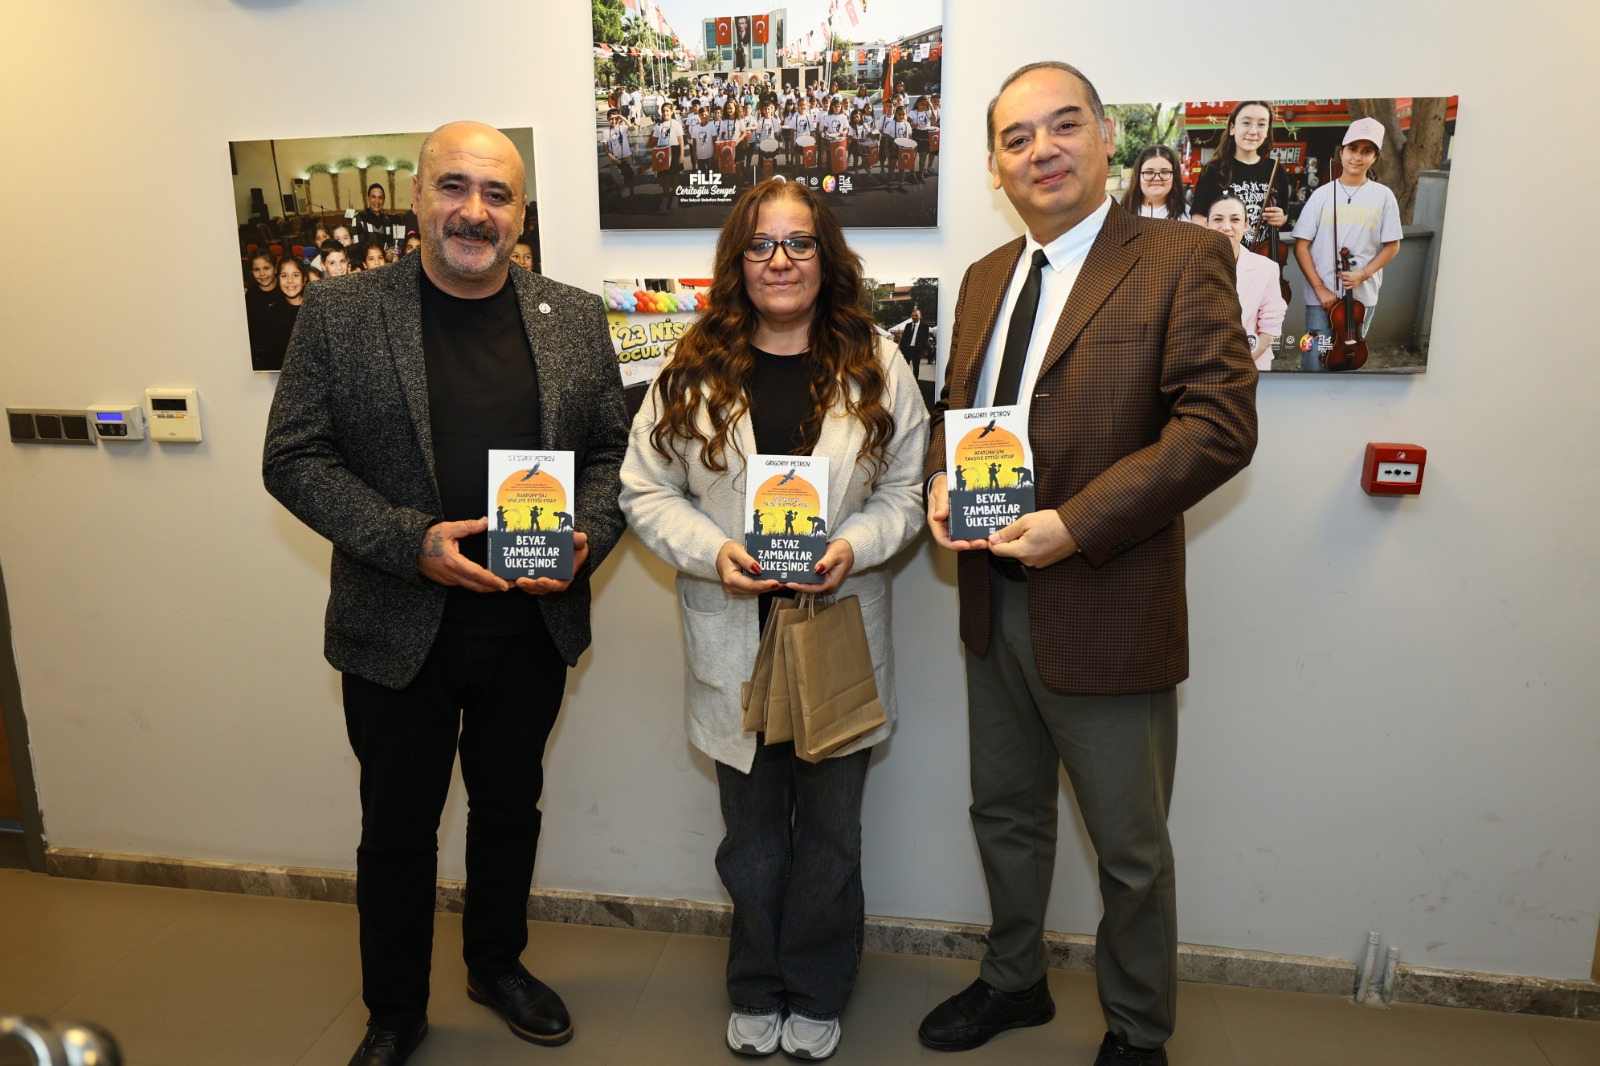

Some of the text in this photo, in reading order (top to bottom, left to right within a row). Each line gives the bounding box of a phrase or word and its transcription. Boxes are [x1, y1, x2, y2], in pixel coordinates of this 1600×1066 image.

[689, 169, 722, 185] FİLİZ
[675, 185, 709, 198] Ceritoğlu
[617, 325, 648, 350] 23
[618, 344, 661, 363] OCUK
[989, 410, 1011, 418] PETROV
[975, 492, 1006, 504] BEYAZ
[962, 504, 1021, 516] ZAMBAKLAR
[516, 535, 546, 546] BEYAZ
[770, 538, 800, 549] BEYAZ
[502, 546, 560, 557] ZAMBAKLAR
[757, 549, 813, 561] ZAMBAKLAR
[504, 556, 558, 568] ÜLKESİNDE
[760, 559, 810, 572] ÜLKESİNDE
